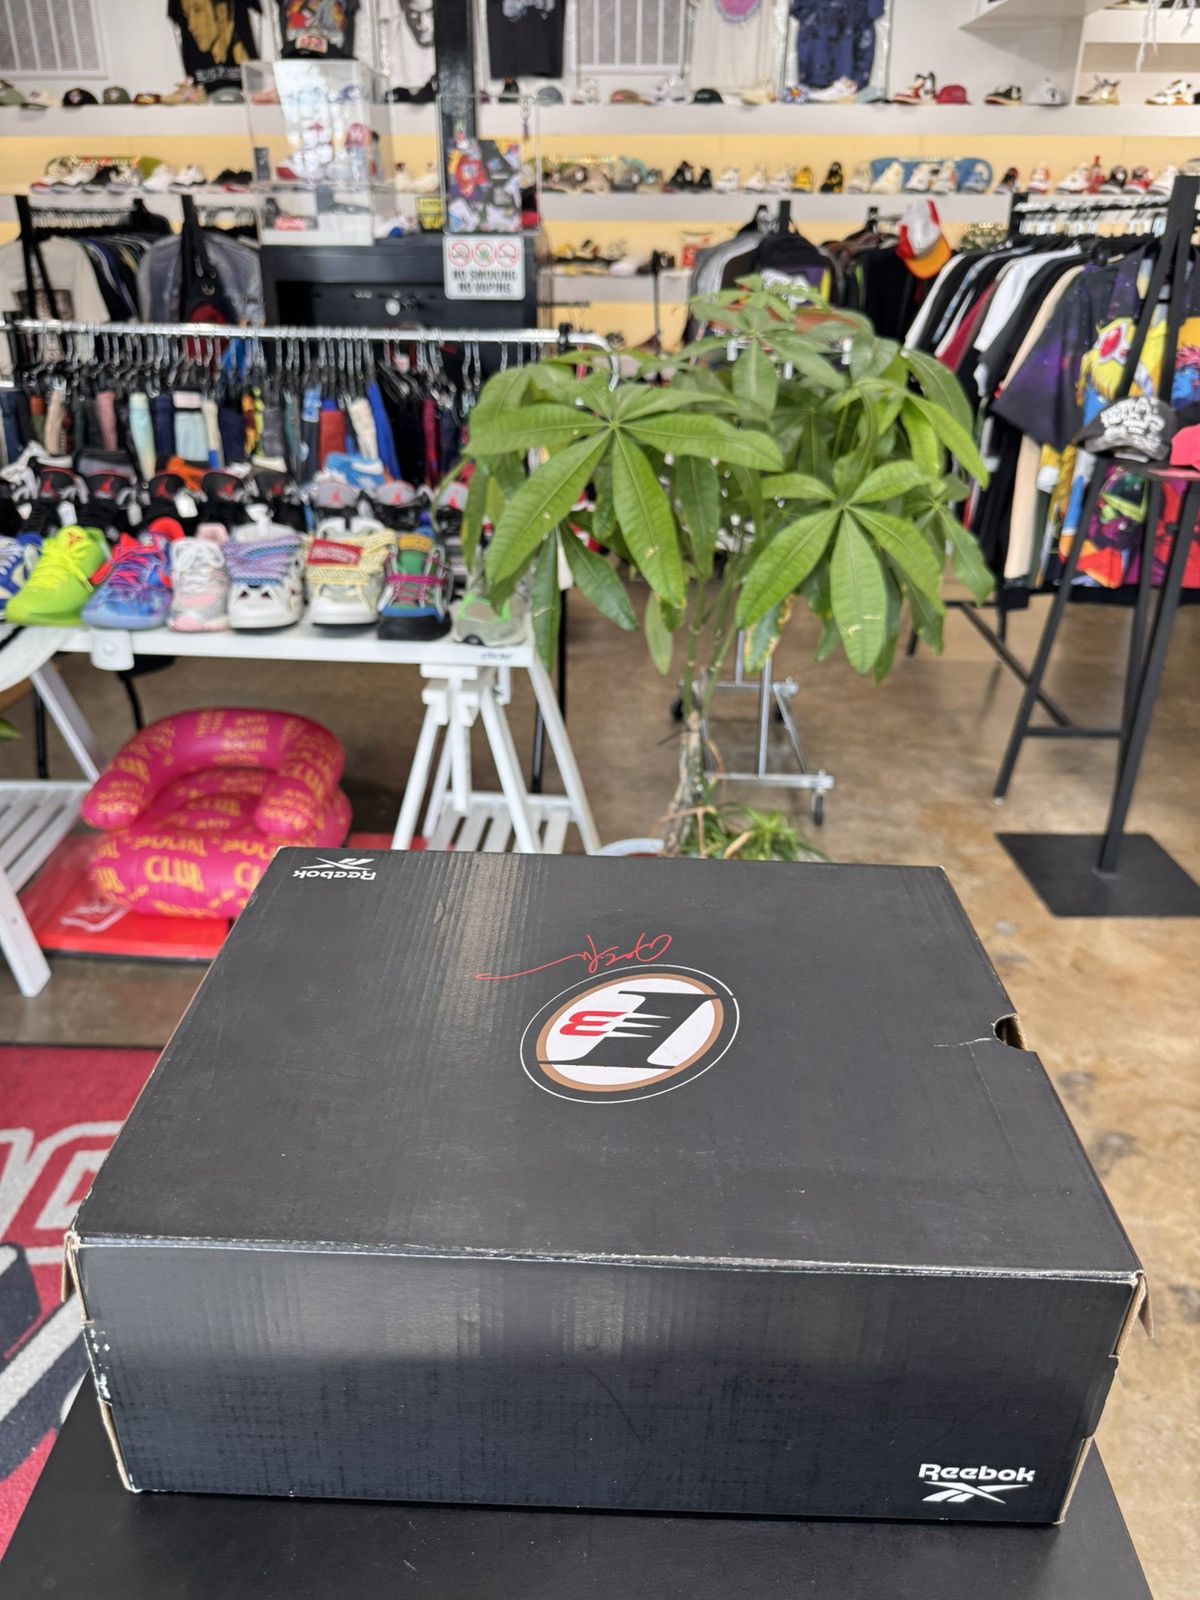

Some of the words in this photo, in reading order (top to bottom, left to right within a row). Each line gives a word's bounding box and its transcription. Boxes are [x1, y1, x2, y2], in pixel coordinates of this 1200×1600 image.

[144, 855, 205, 893] CLUB
[292, 870, 377, 881] Reebok
[918, 1463, 1036, 1482] Reebok
